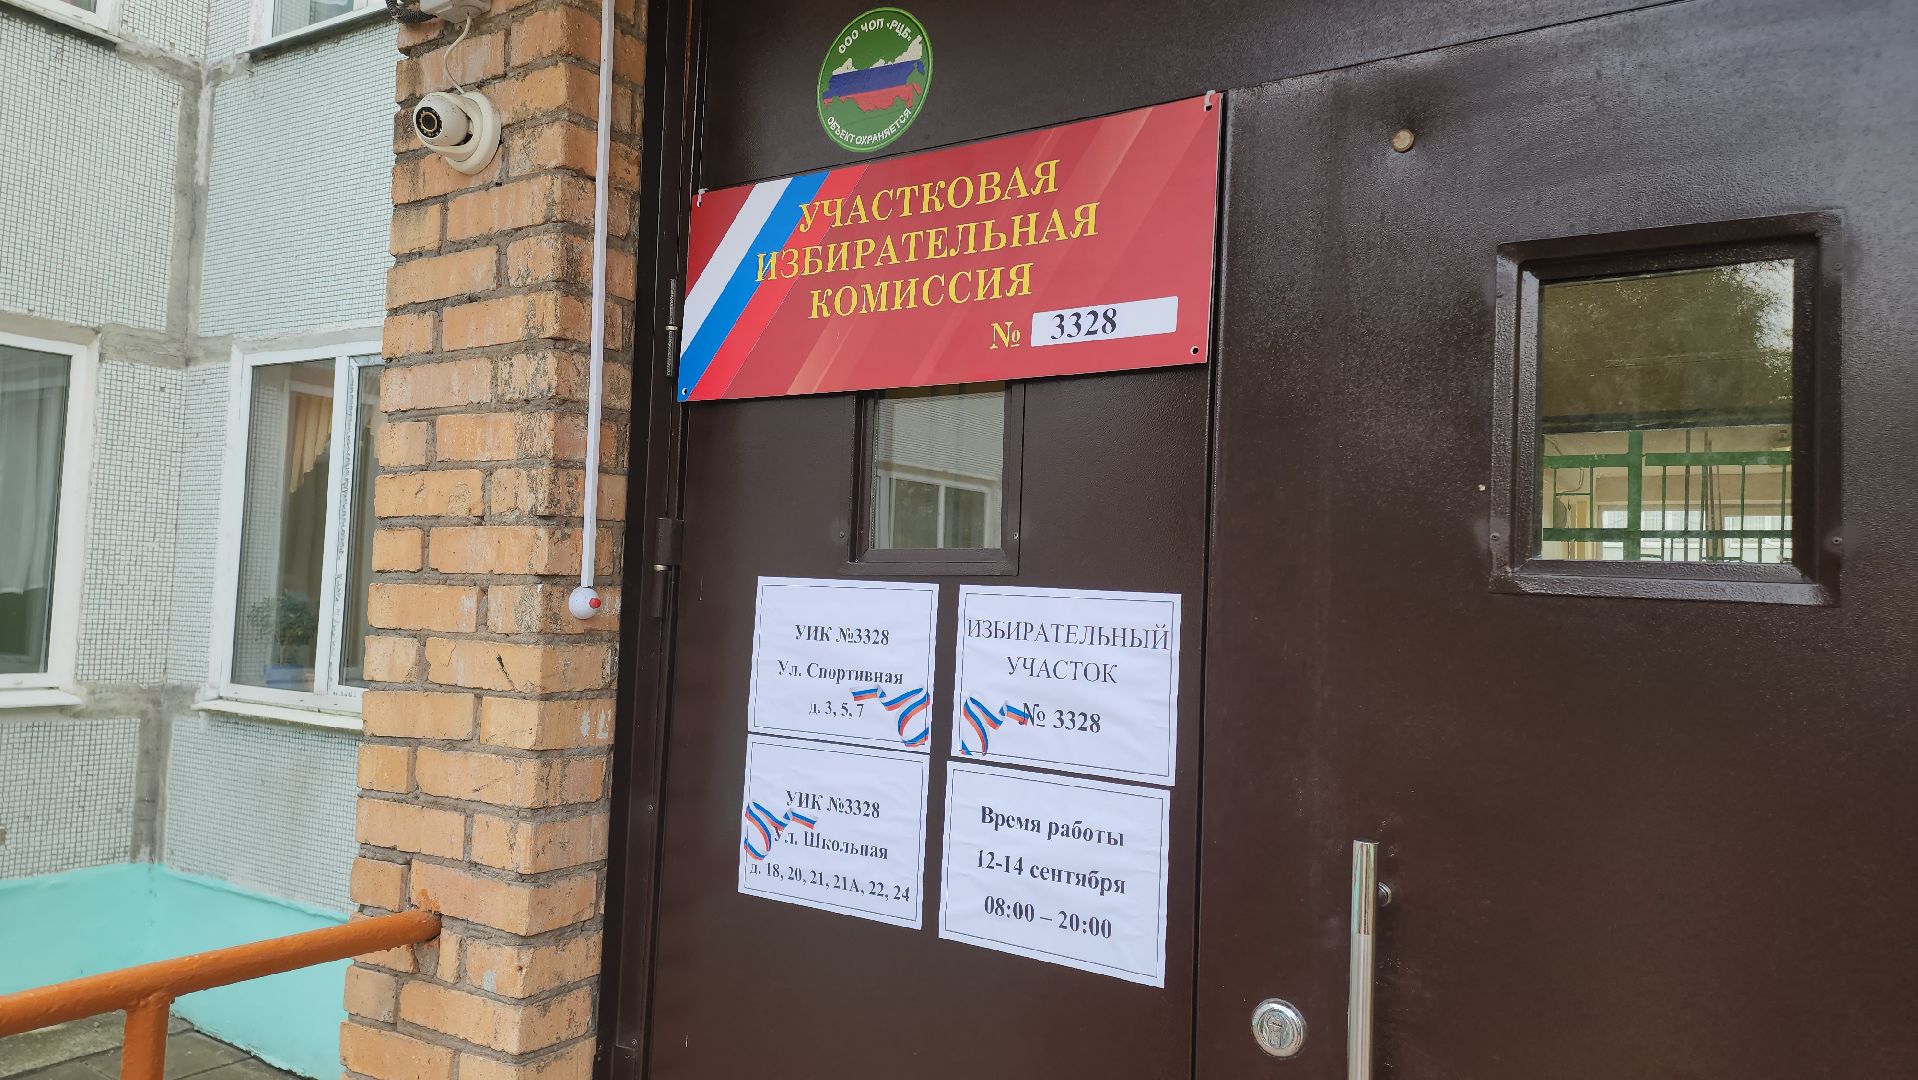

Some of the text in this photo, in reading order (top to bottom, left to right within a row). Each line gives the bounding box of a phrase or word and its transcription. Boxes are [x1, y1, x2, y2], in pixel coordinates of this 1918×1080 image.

[838, 18, 912, 54] ООО ЧОП «РЦБ»
[827, 107, 912, 145] ОБЪЕКТ ОХРАНЯЕТСЯ
[798, 159, 1060, 234] УЧАСТКОВАЯ
[754, 201, 1100, 283] ИЗБИРАТЕЛЬНАЯ
[808, 261, 1034, 320] КОМИССИЯ
[989, 306, 1118, 351] № 3328
[795, 624, 890, 646] УИК №3328
[966, 619, 1169, 650] ИЗБИРАТЕЛЬНЫЙ
[777, 659, 903, 684] Ул. Спортивная
[1006, 656, 1118, 684] УЧАСТОК
[808, 700, 864, 718] д. 3, 5, 7
[1019, 702, 1101, 733] № 3328
[786, 789, 880, 819] УИК №3328
[774, 826, 888, 860] Ул. Школьная
[981, 805, 1124, 847] Время работы
[750, 862, 910, 902] д. 18, 20, 21, 21А, 22, 24
[977, 849, 1126, 896] 12-14 сентября
[984, 895, 1035, 922] 08:00
[1058, 910, 1112, 939] 20:00
